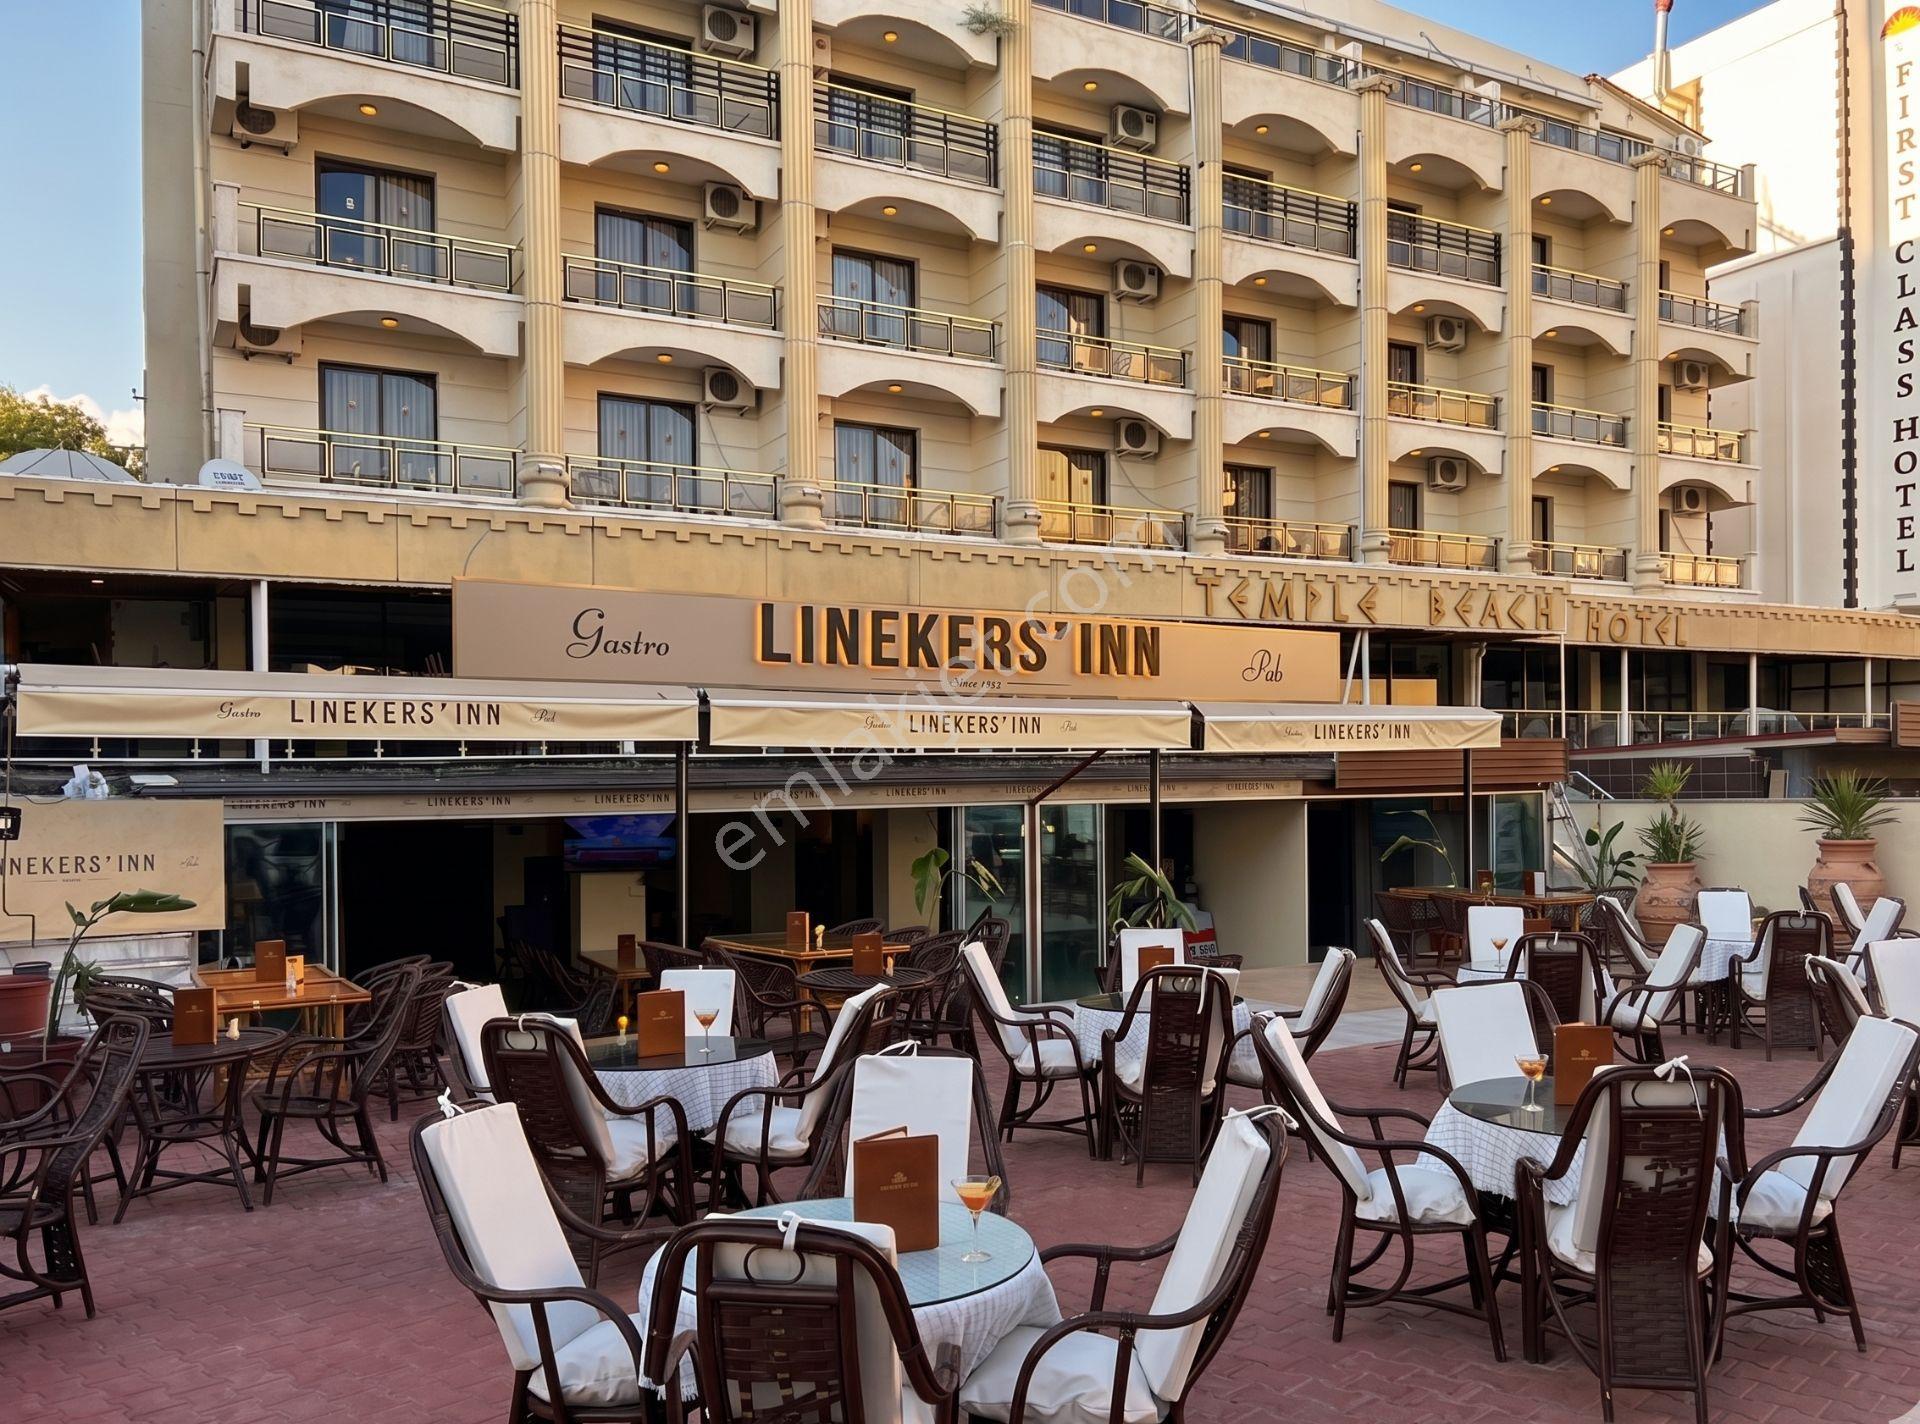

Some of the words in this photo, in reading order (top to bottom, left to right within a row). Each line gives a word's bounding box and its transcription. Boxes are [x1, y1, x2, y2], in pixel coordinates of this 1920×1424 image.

[1895, 61, 1917, 220] FIRST
[1894, 241, 1919, 398] CLASS
[1893, 416, 1920, 572] HOTEL
[565, 607, 670, 659] Gastro
[1195, 577, 1380, 624] TEMPLE
[1429, 588, 1553, 630] BEACH
[1587, 606, 1688, 647] HOTEL
[217, 701, 261, 719] Gastro
